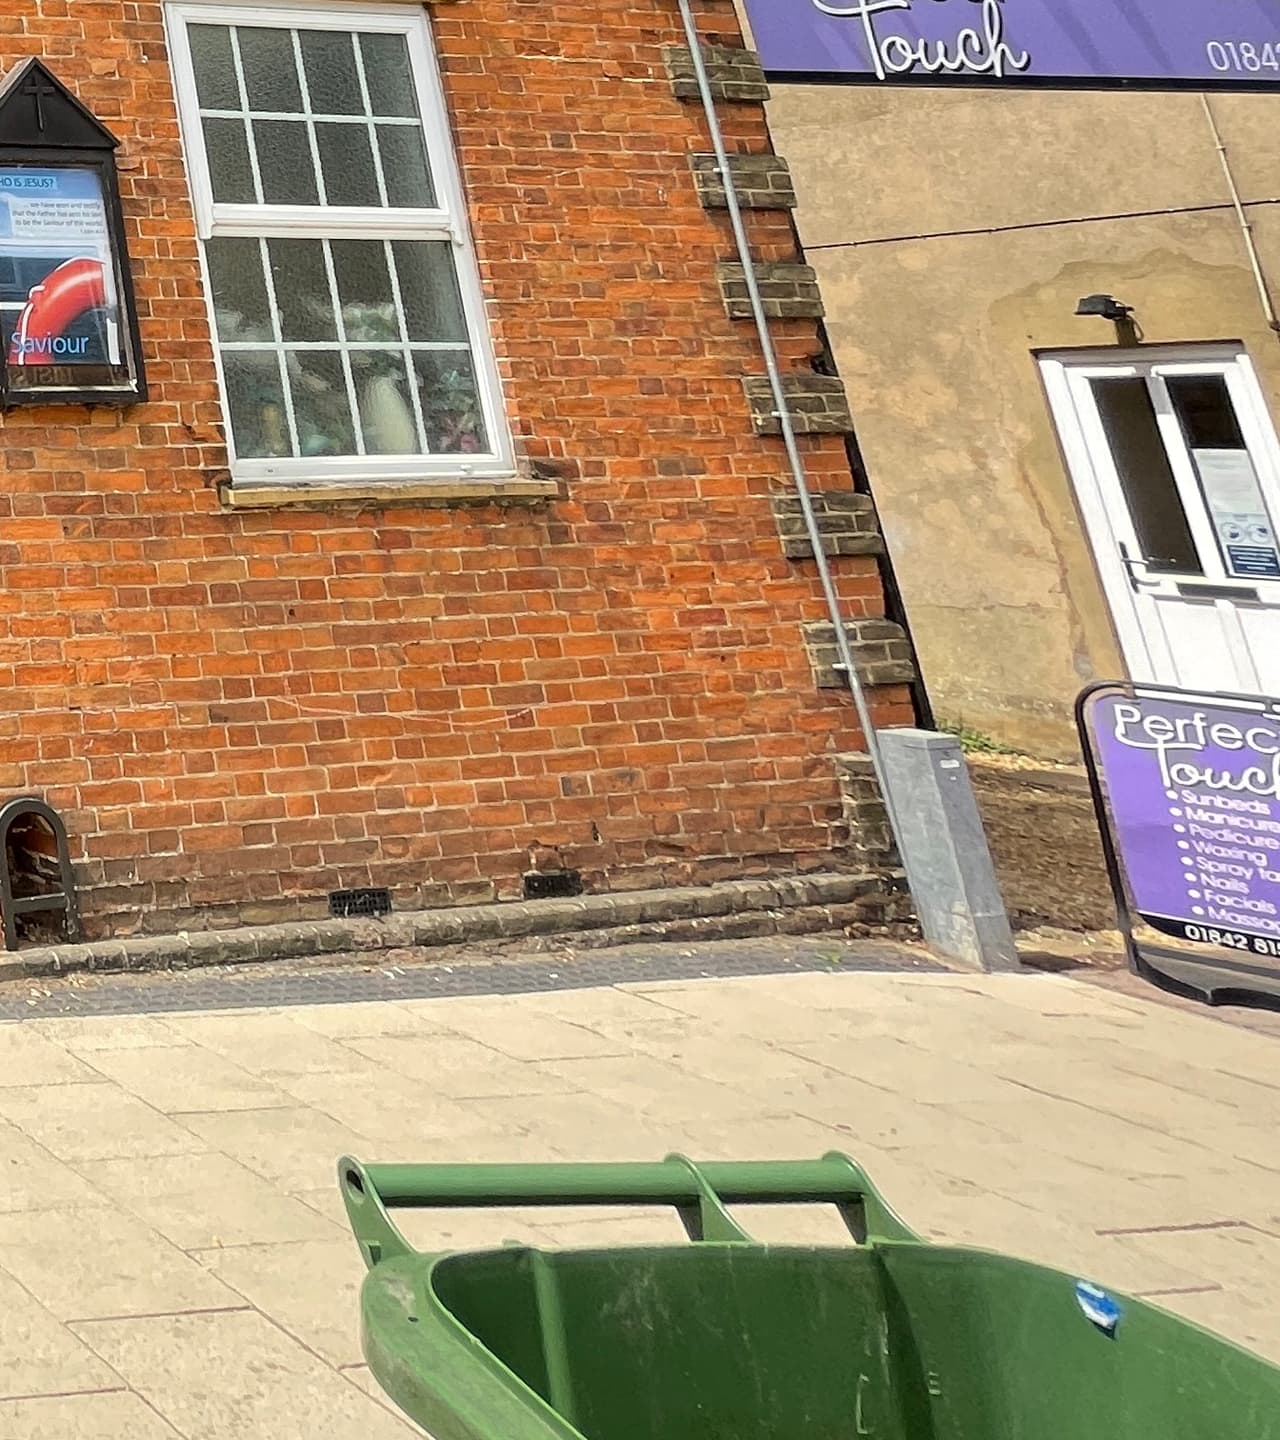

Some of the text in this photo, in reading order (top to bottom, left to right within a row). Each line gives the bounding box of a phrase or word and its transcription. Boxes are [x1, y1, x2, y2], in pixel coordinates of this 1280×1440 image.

[14, 178, 23, 188] IS
[24, 177, 55, 189] JESUS?
[11, 331, 89, 355] Saviour
[1113, 703, 1280, 755] Perfec
[1181, 789, 1271, 815] Sunbeds
[1188, 822, 1280, 850] Pedicure
[1191, 839, 1268, 867] Waxing
[1195, 855, 1280, 883] Spray ta
[1199, 872, 1251, 895] Nails
[1202, 888, 1278, 915] Facials
[1184, 924, 1250, 951] 01842
